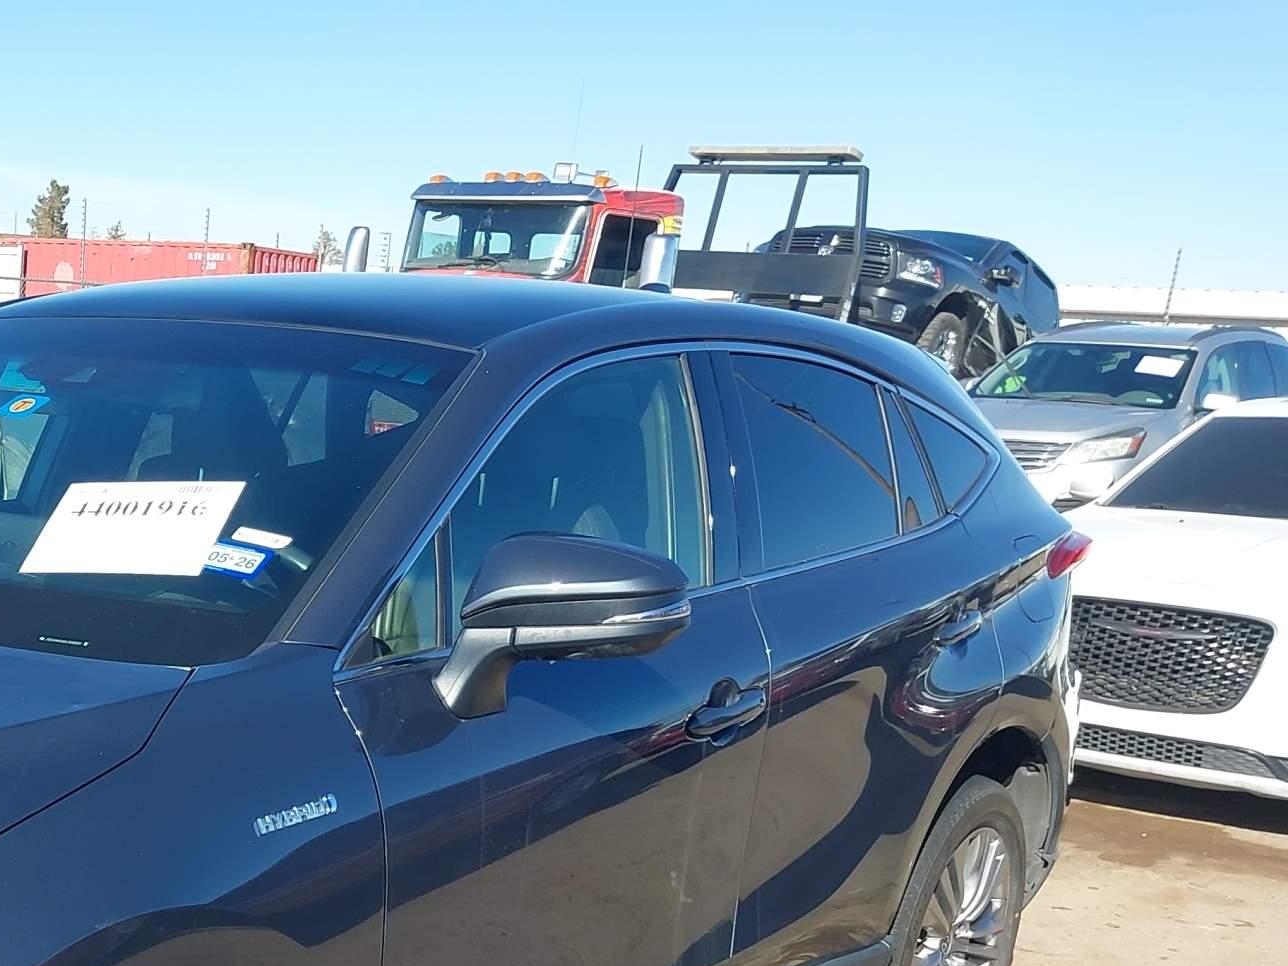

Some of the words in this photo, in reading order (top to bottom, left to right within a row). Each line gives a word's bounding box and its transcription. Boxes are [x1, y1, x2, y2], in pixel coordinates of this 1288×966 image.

[71, 499, 208, 517] 44001916
[234, 556, 258, 569] 26
[253, 793, 339, 837] HYBRID
